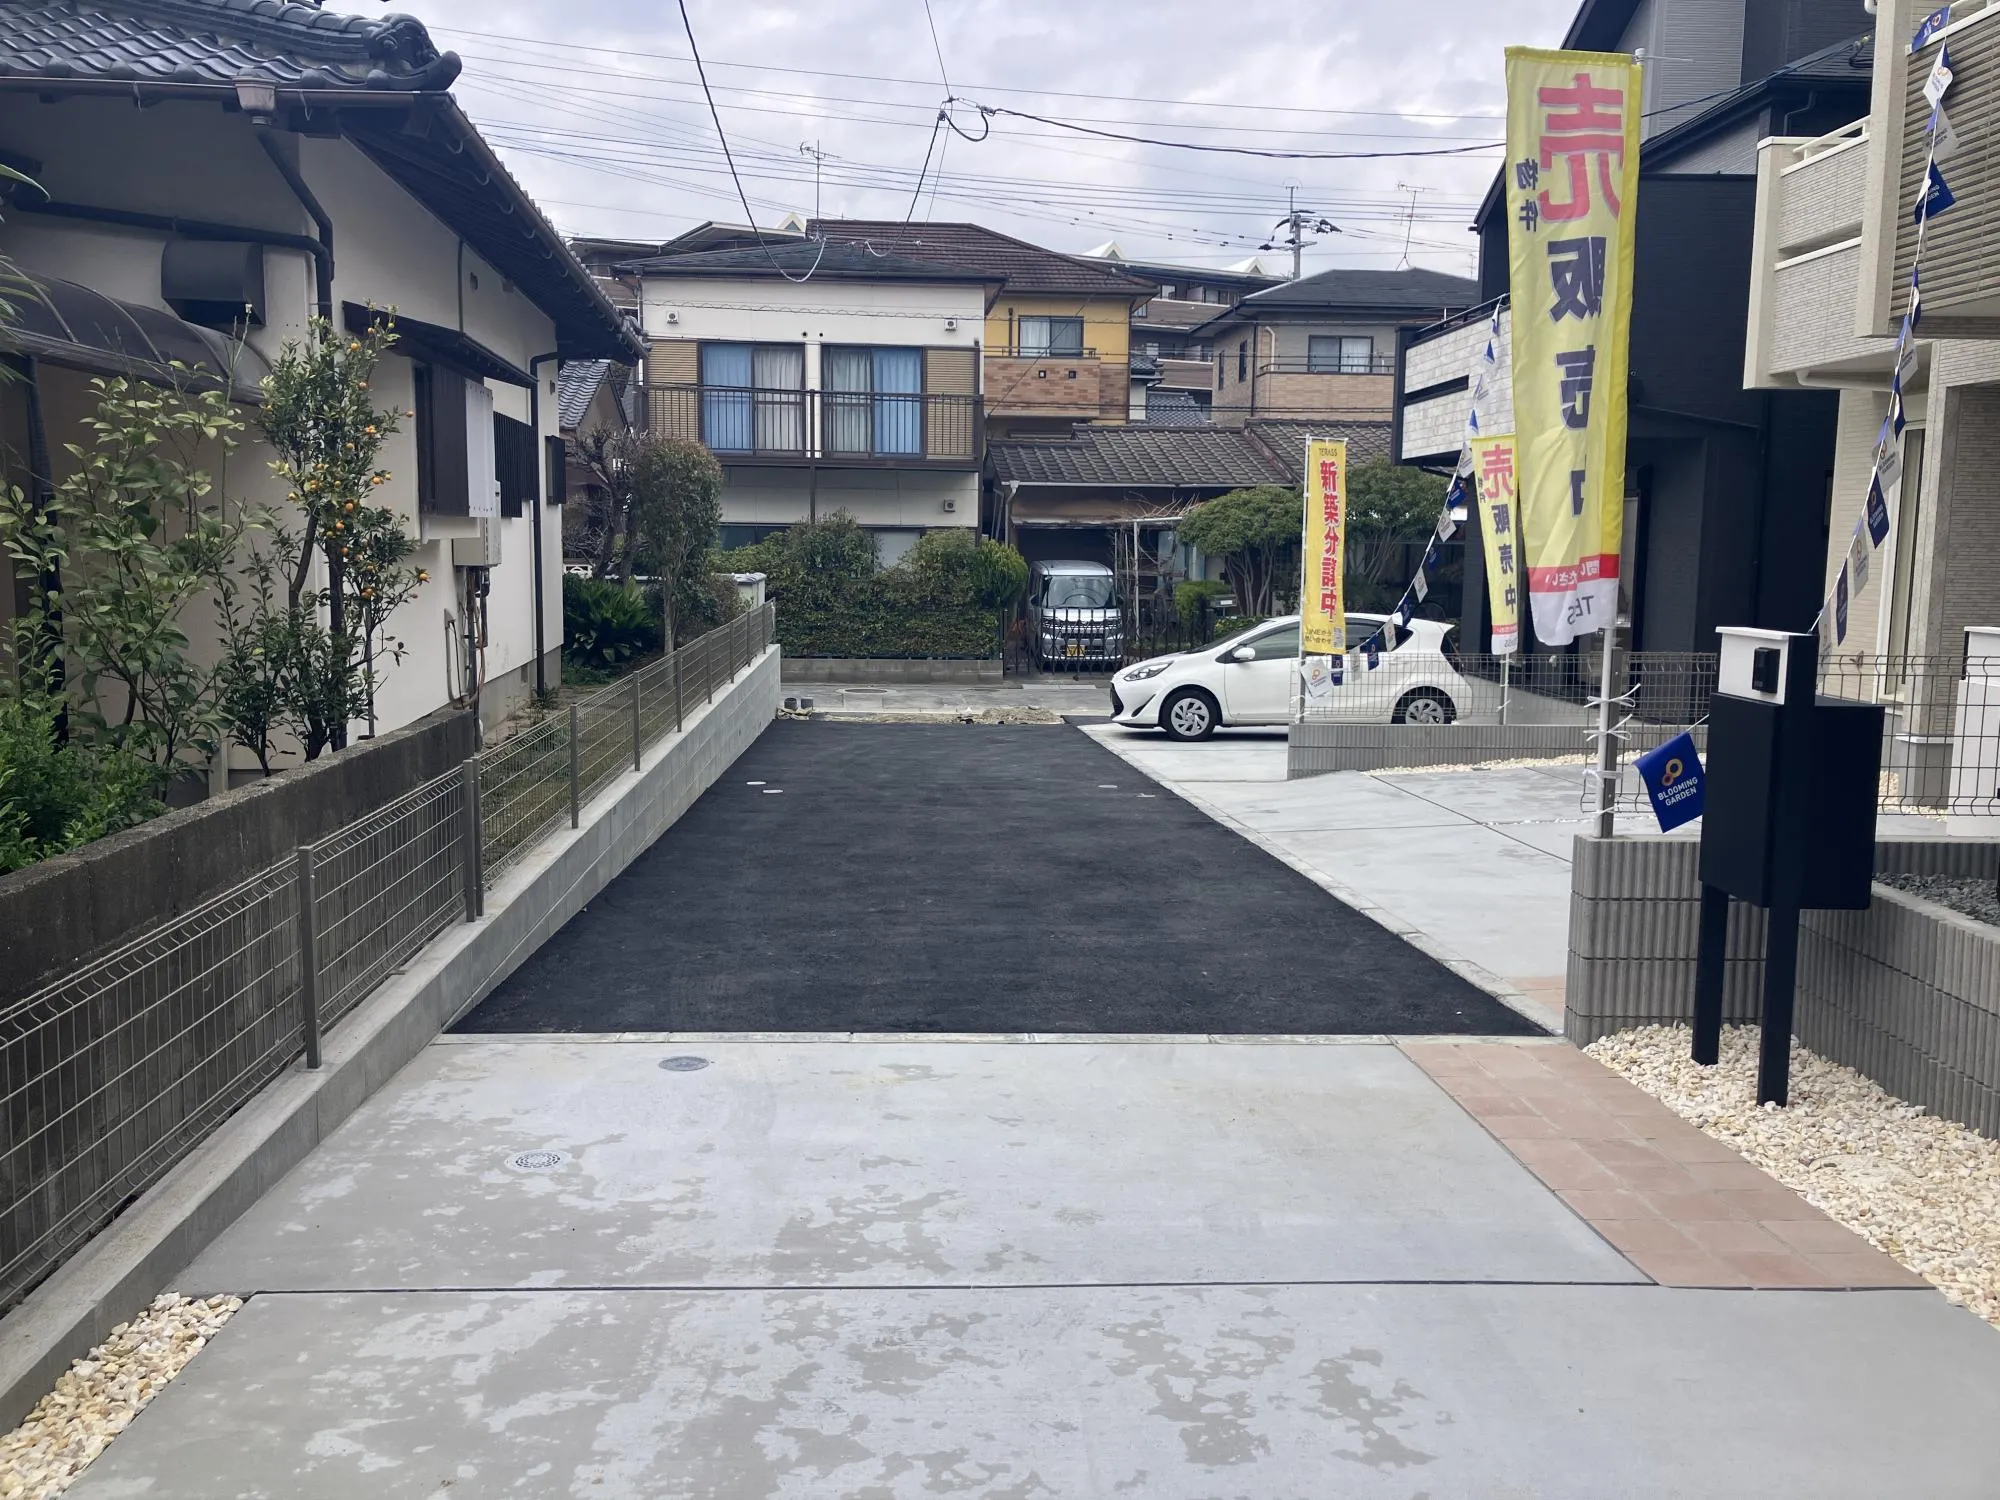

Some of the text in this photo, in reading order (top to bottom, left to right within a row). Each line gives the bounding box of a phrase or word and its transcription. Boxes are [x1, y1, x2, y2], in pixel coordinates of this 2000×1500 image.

[1318, 448, 1338, 457] TERASS
[1320, 460, 1339, 621] 新築分譲中
[1657, 776, 1698, 801] BLOOMING
[1665, 787, 1697, 806] GARDEN
